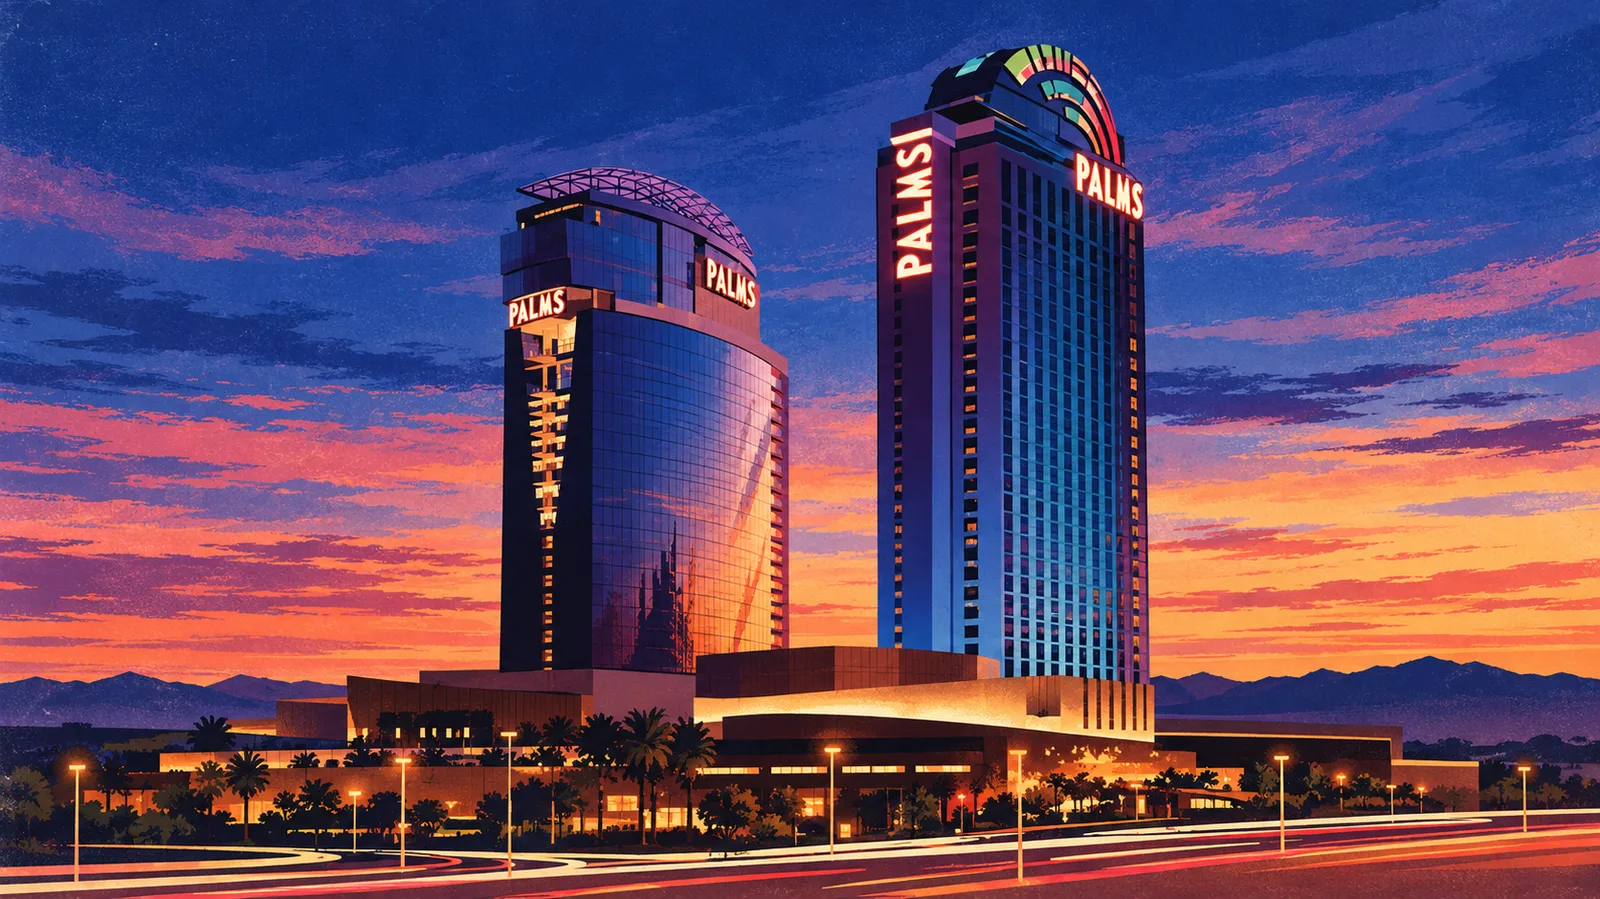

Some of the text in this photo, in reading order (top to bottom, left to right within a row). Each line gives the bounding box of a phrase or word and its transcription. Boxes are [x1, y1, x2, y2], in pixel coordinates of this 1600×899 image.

[1075, 152, 1144, 220] PALMS
[706, 257, 756, 308] PALMS
[508, 289, 565, 328] PALMS
